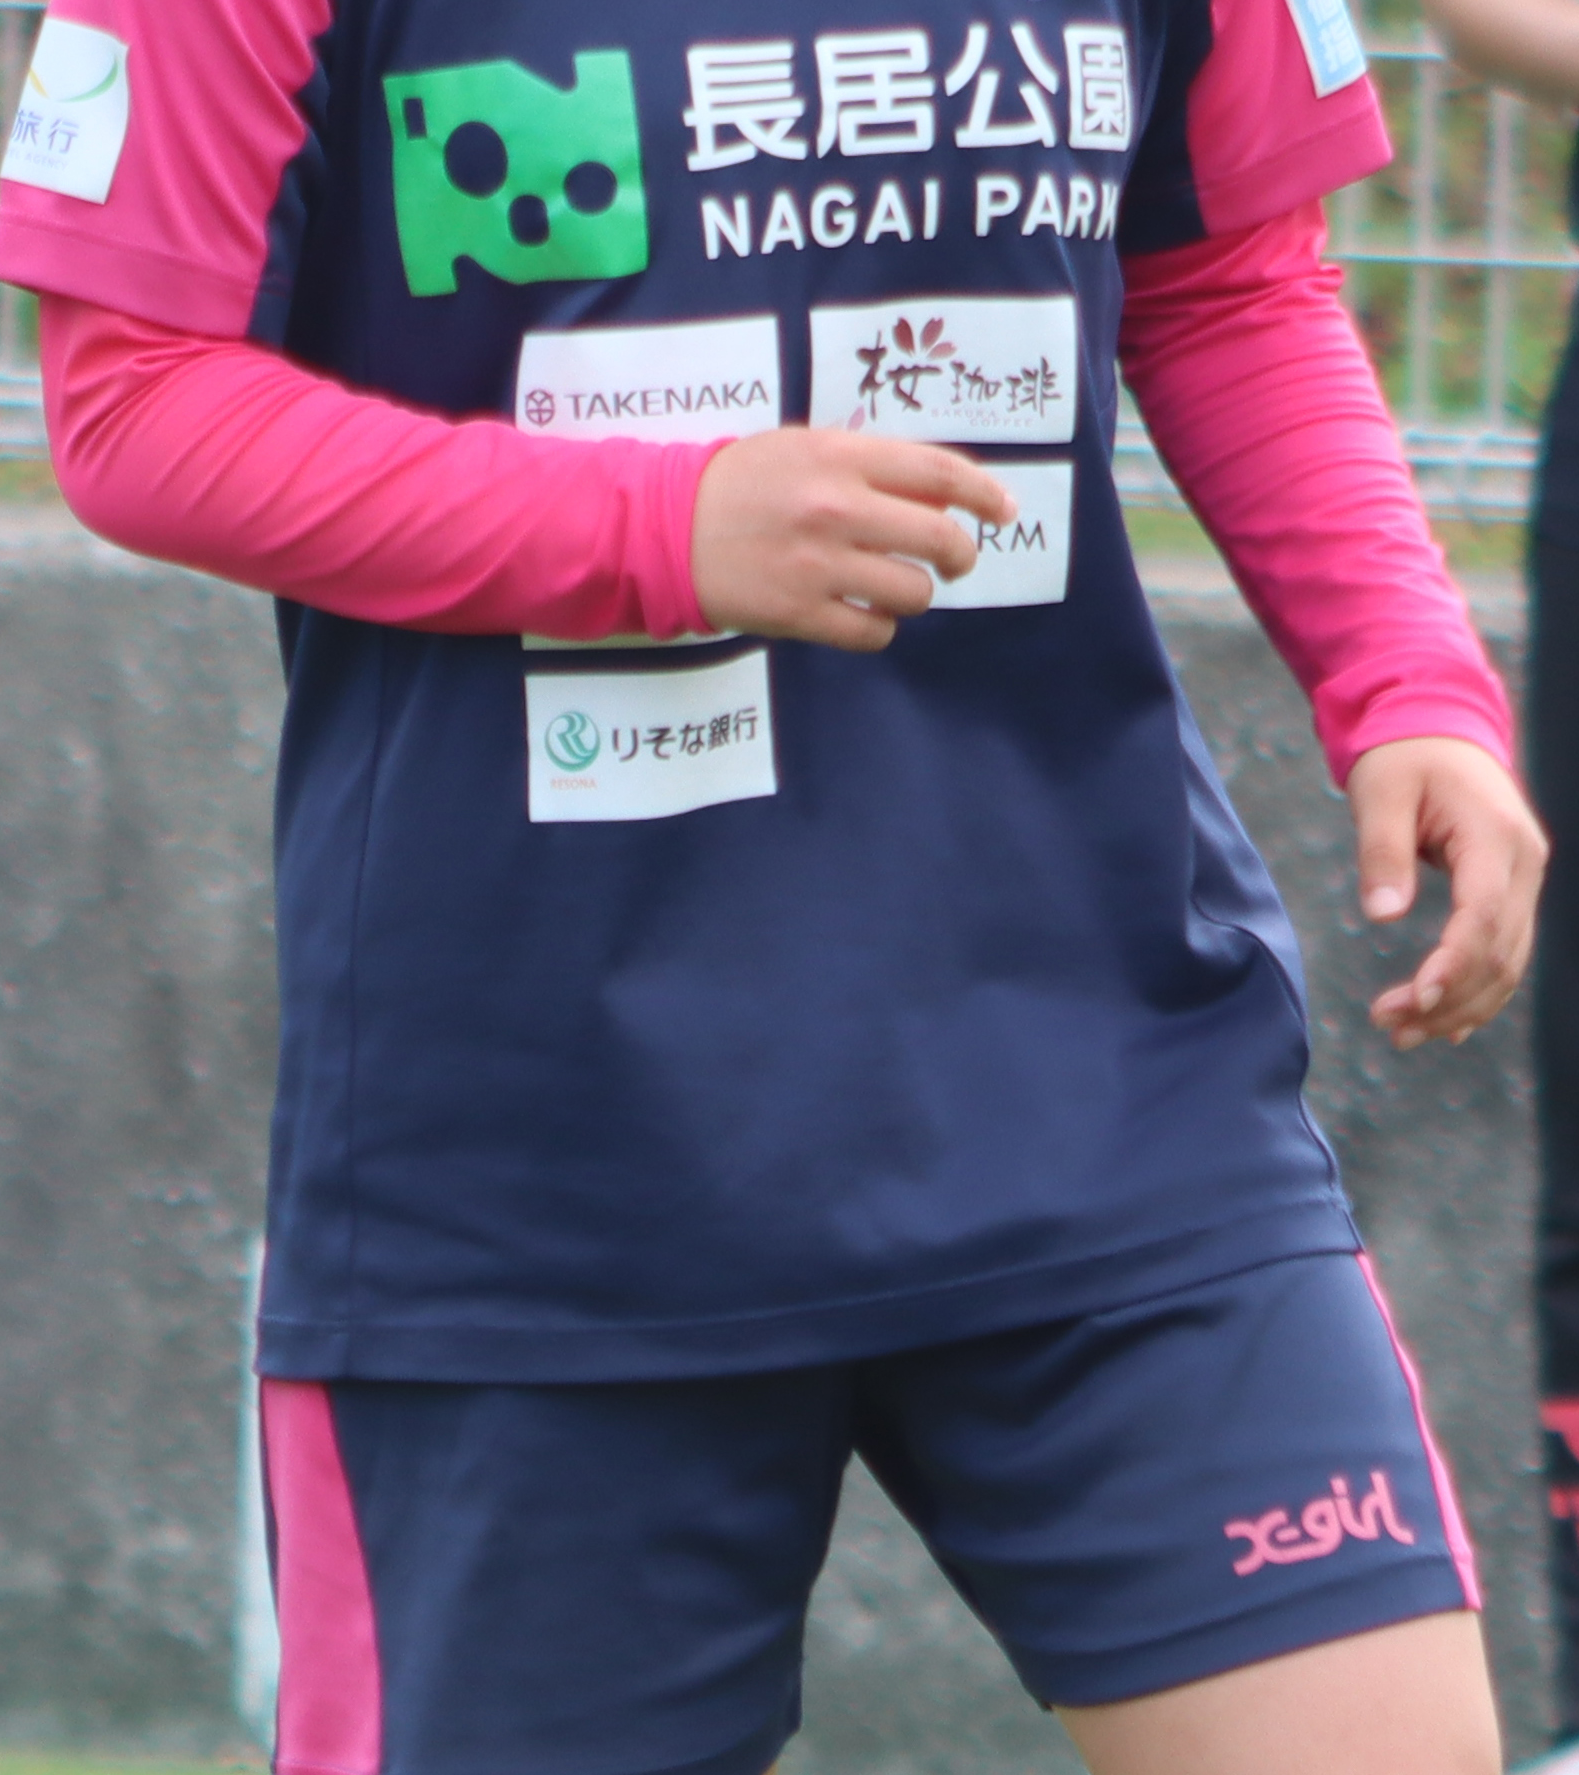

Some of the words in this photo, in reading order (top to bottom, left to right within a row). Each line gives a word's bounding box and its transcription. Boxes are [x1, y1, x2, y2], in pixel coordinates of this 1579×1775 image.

[683, 23, 1132, 172] 長居公園
[701, 180, 940, 260] NAGAI
[975, 174, 1119, 241] PARK
[565, 380, 770, 421] TAKENAKA
[978, 521, 1046, 553] RM
[612, 707, 759, 763] りそな銀行
